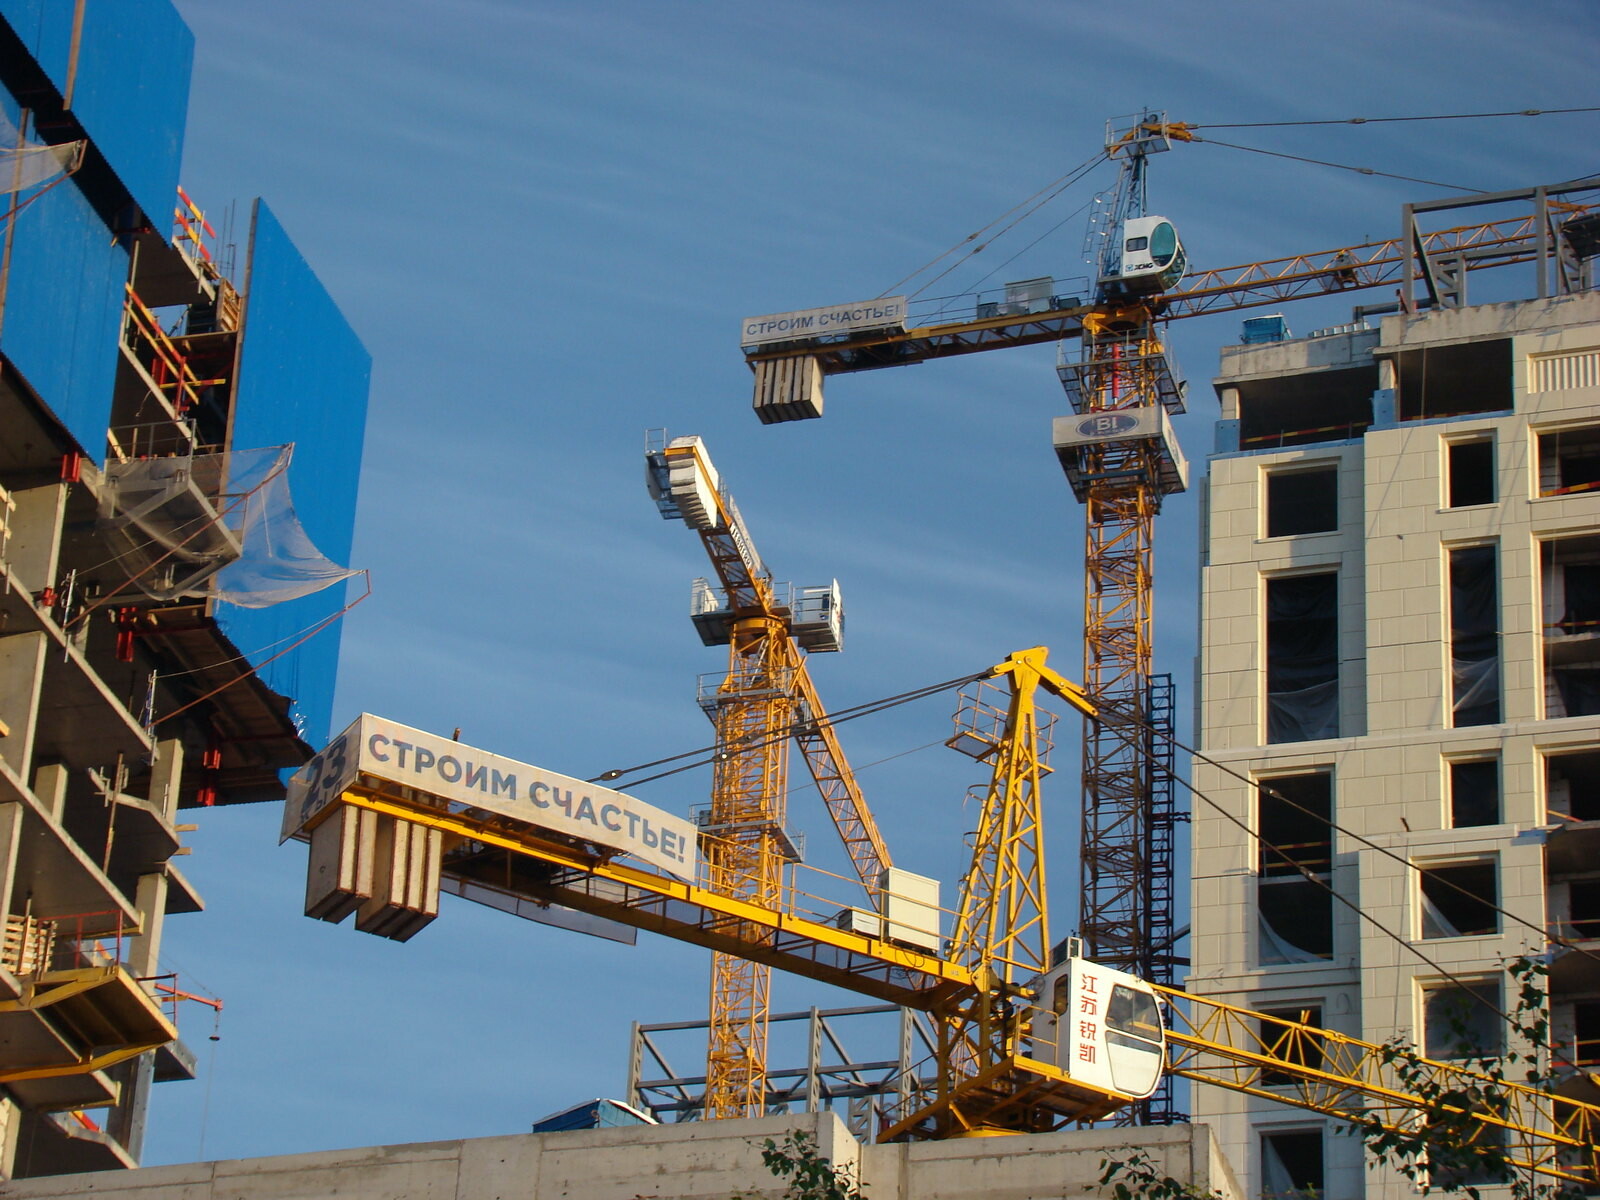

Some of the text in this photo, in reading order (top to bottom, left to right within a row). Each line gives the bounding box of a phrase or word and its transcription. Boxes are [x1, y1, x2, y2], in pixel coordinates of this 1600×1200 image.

[746, 304, 899, 336] СТРОИМ СЧАСТЬЕ!
[1096, 416, 1118, 431] BI
[301, 734, 347, 814] 23
[368, 733, 686, 864] СТРОИМ СЧАСТЬЕ!
[1079, 973, 1098, 1064] 江苏锐凯
